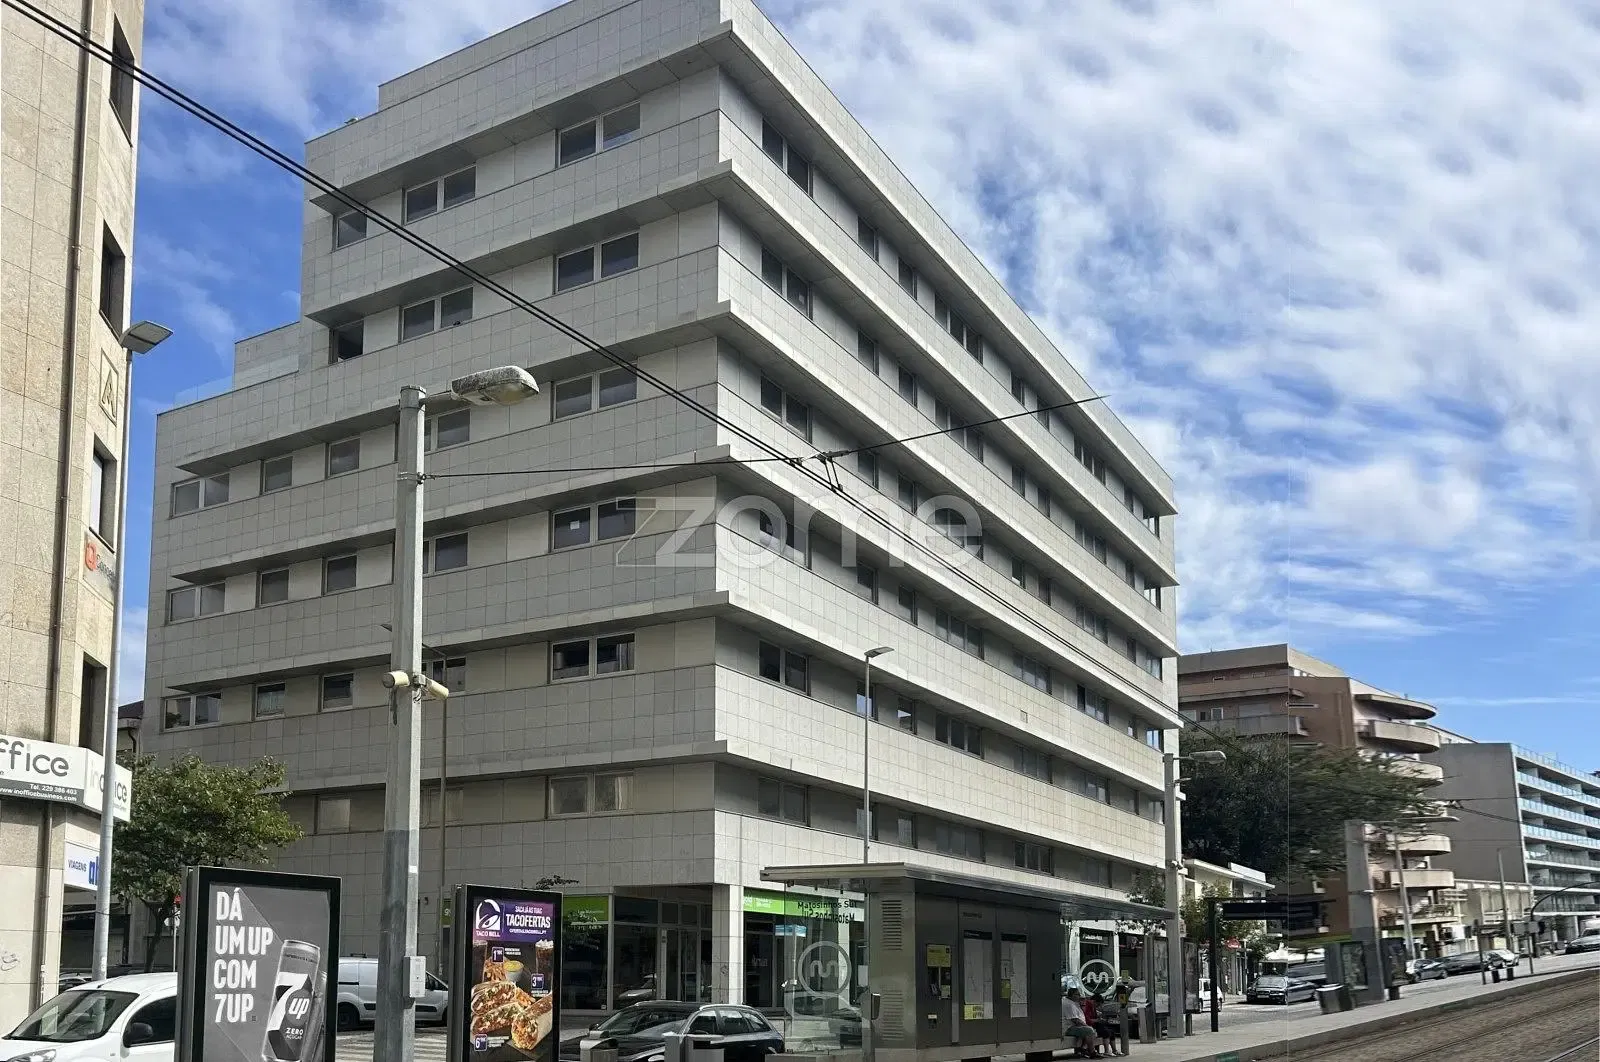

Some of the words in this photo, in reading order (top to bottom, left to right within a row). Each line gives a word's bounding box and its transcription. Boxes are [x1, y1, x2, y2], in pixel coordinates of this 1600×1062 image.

[68, 859, 87, 872] VIAGENS
[216, 887, 243, 921] DÁ
[797, 901, 842, 909] Matosinhos
[844, 899, 857, 908] Sul
[506, 914, 551, 928] TACOFERTAS
[215, 925, 245, 955] UM
[248, 926, 274, 956] UP
[214, 959, 257, 989] COM
[214, 993, 254, 1023] 7UP
[286, 1027, 304, 1035] ZERO
